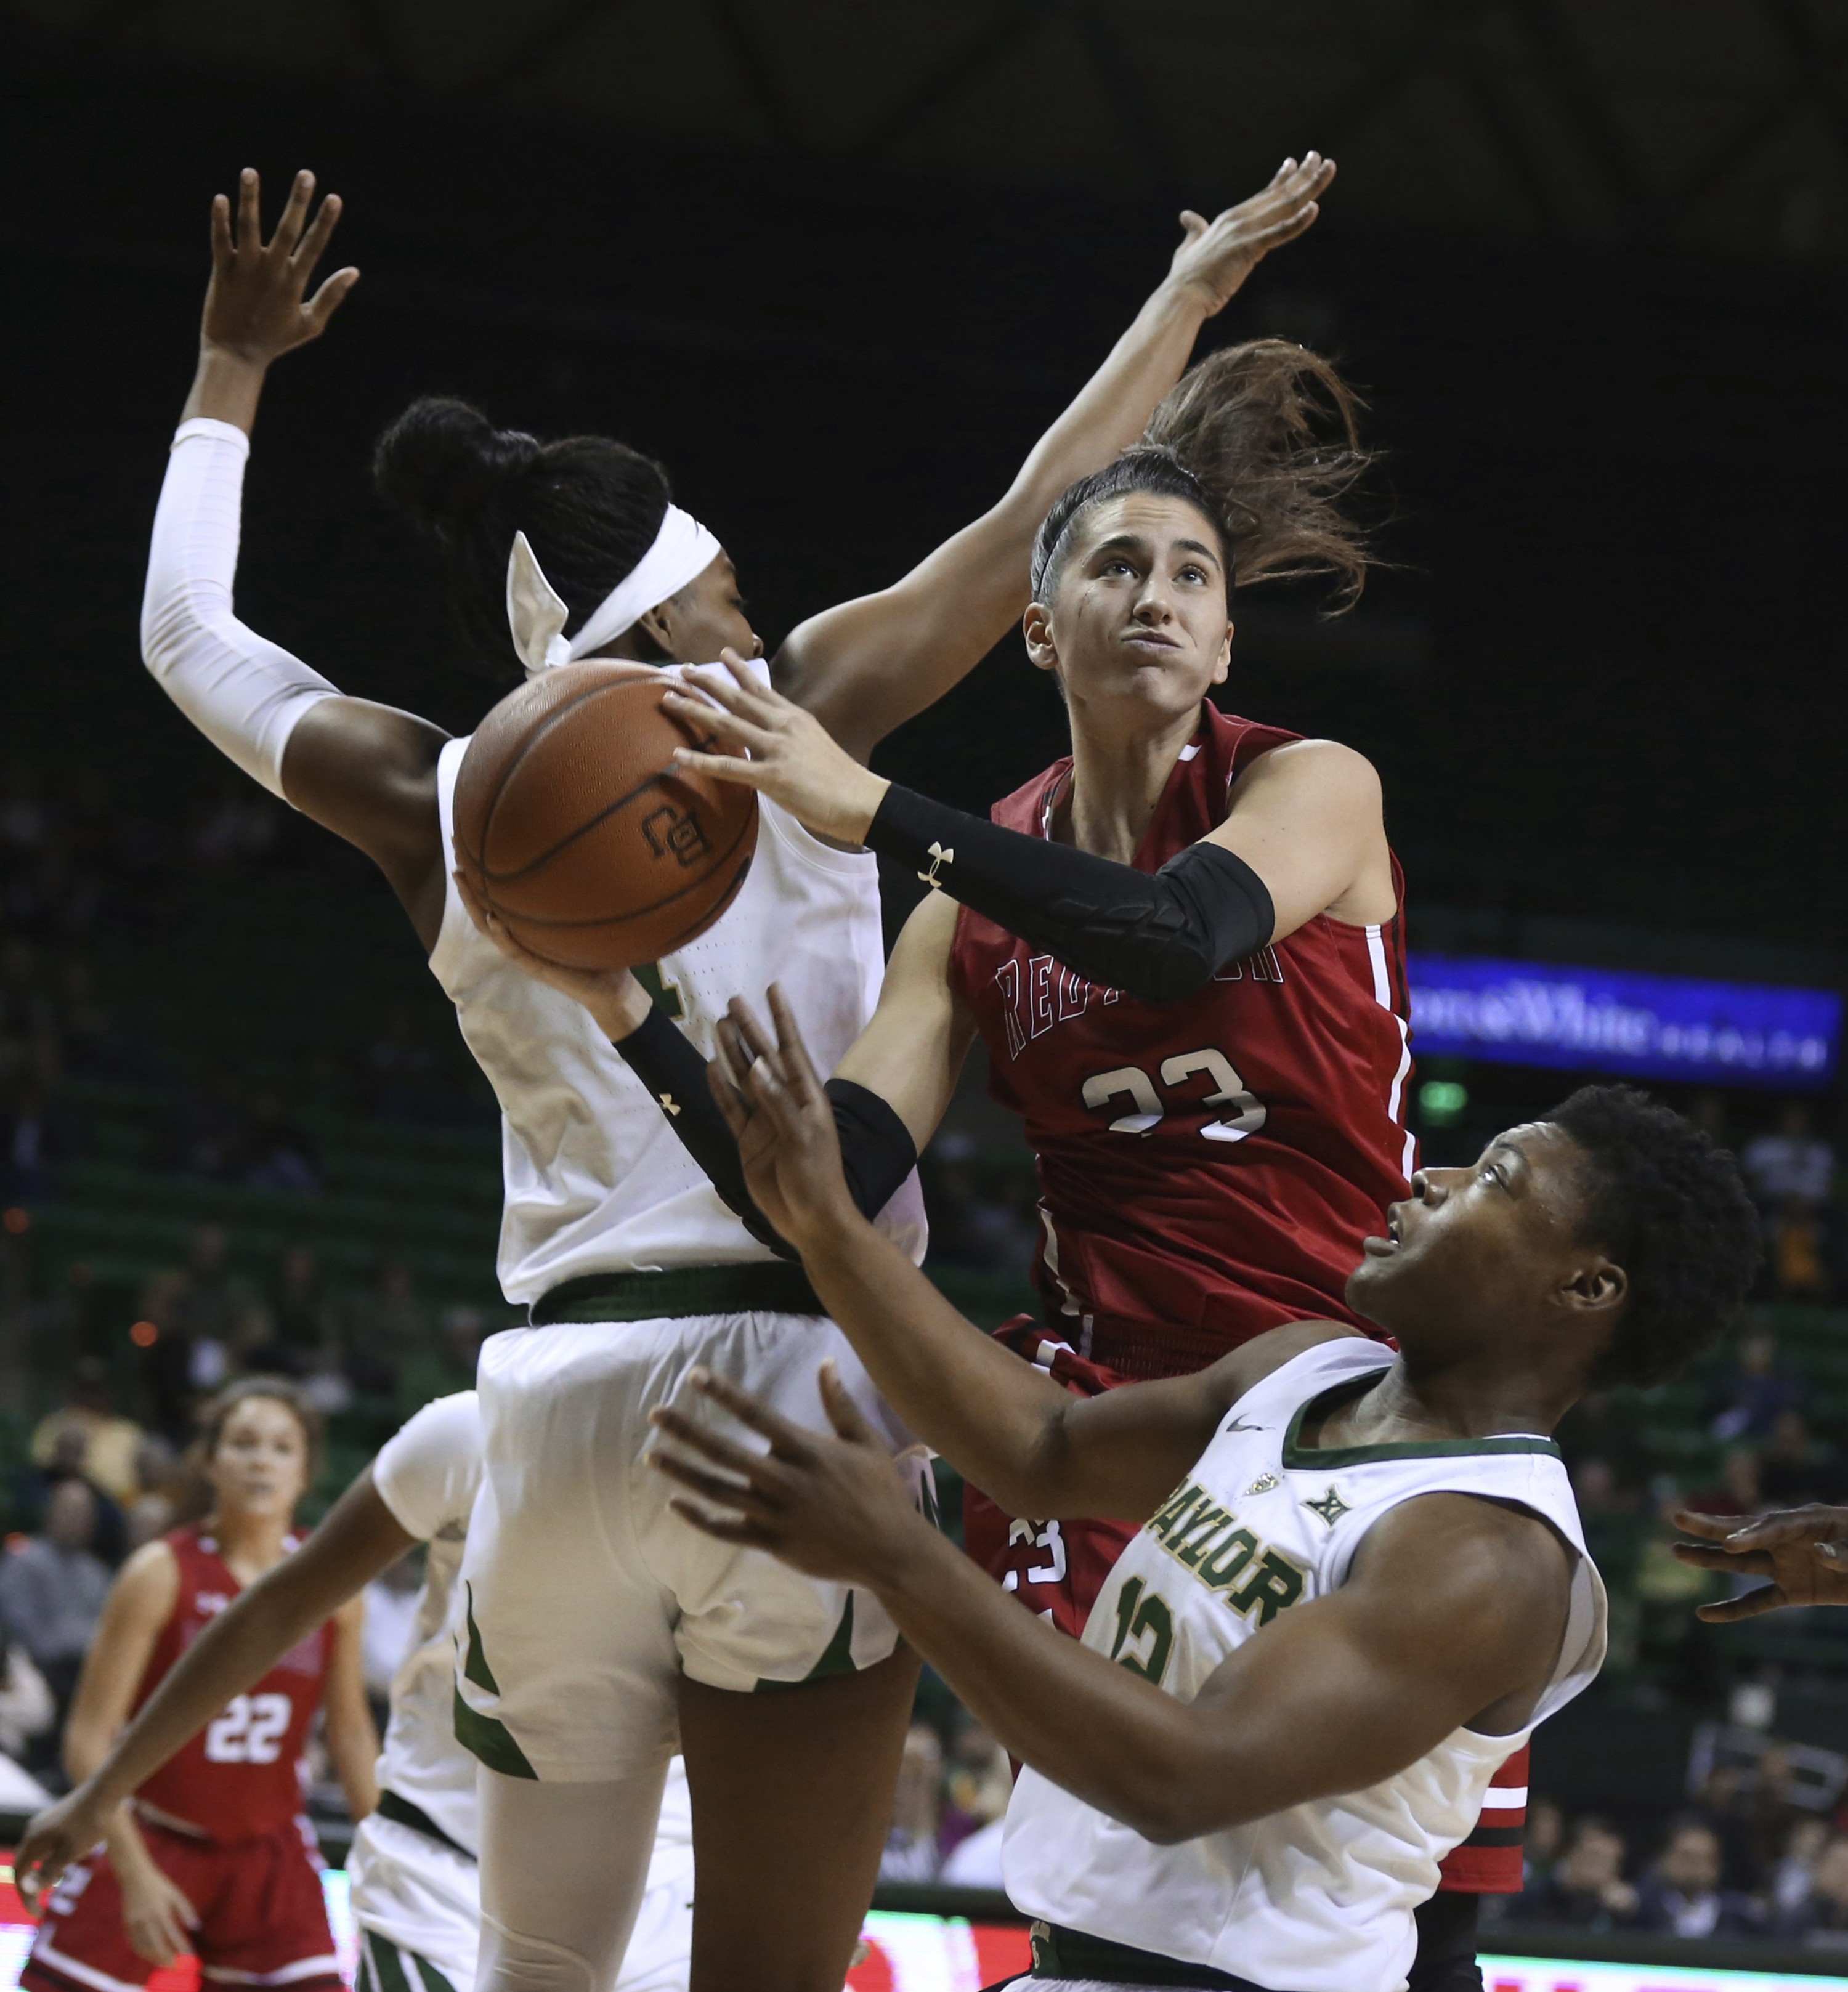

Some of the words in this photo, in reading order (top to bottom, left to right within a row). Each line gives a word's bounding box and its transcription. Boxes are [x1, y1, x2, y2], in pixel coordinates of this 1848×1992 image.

[1082, 1048, 1268, 1143] 23
[1144, 1471, 1307, 1629] AYLOR
[204, 1692, 293, 1765] 22
